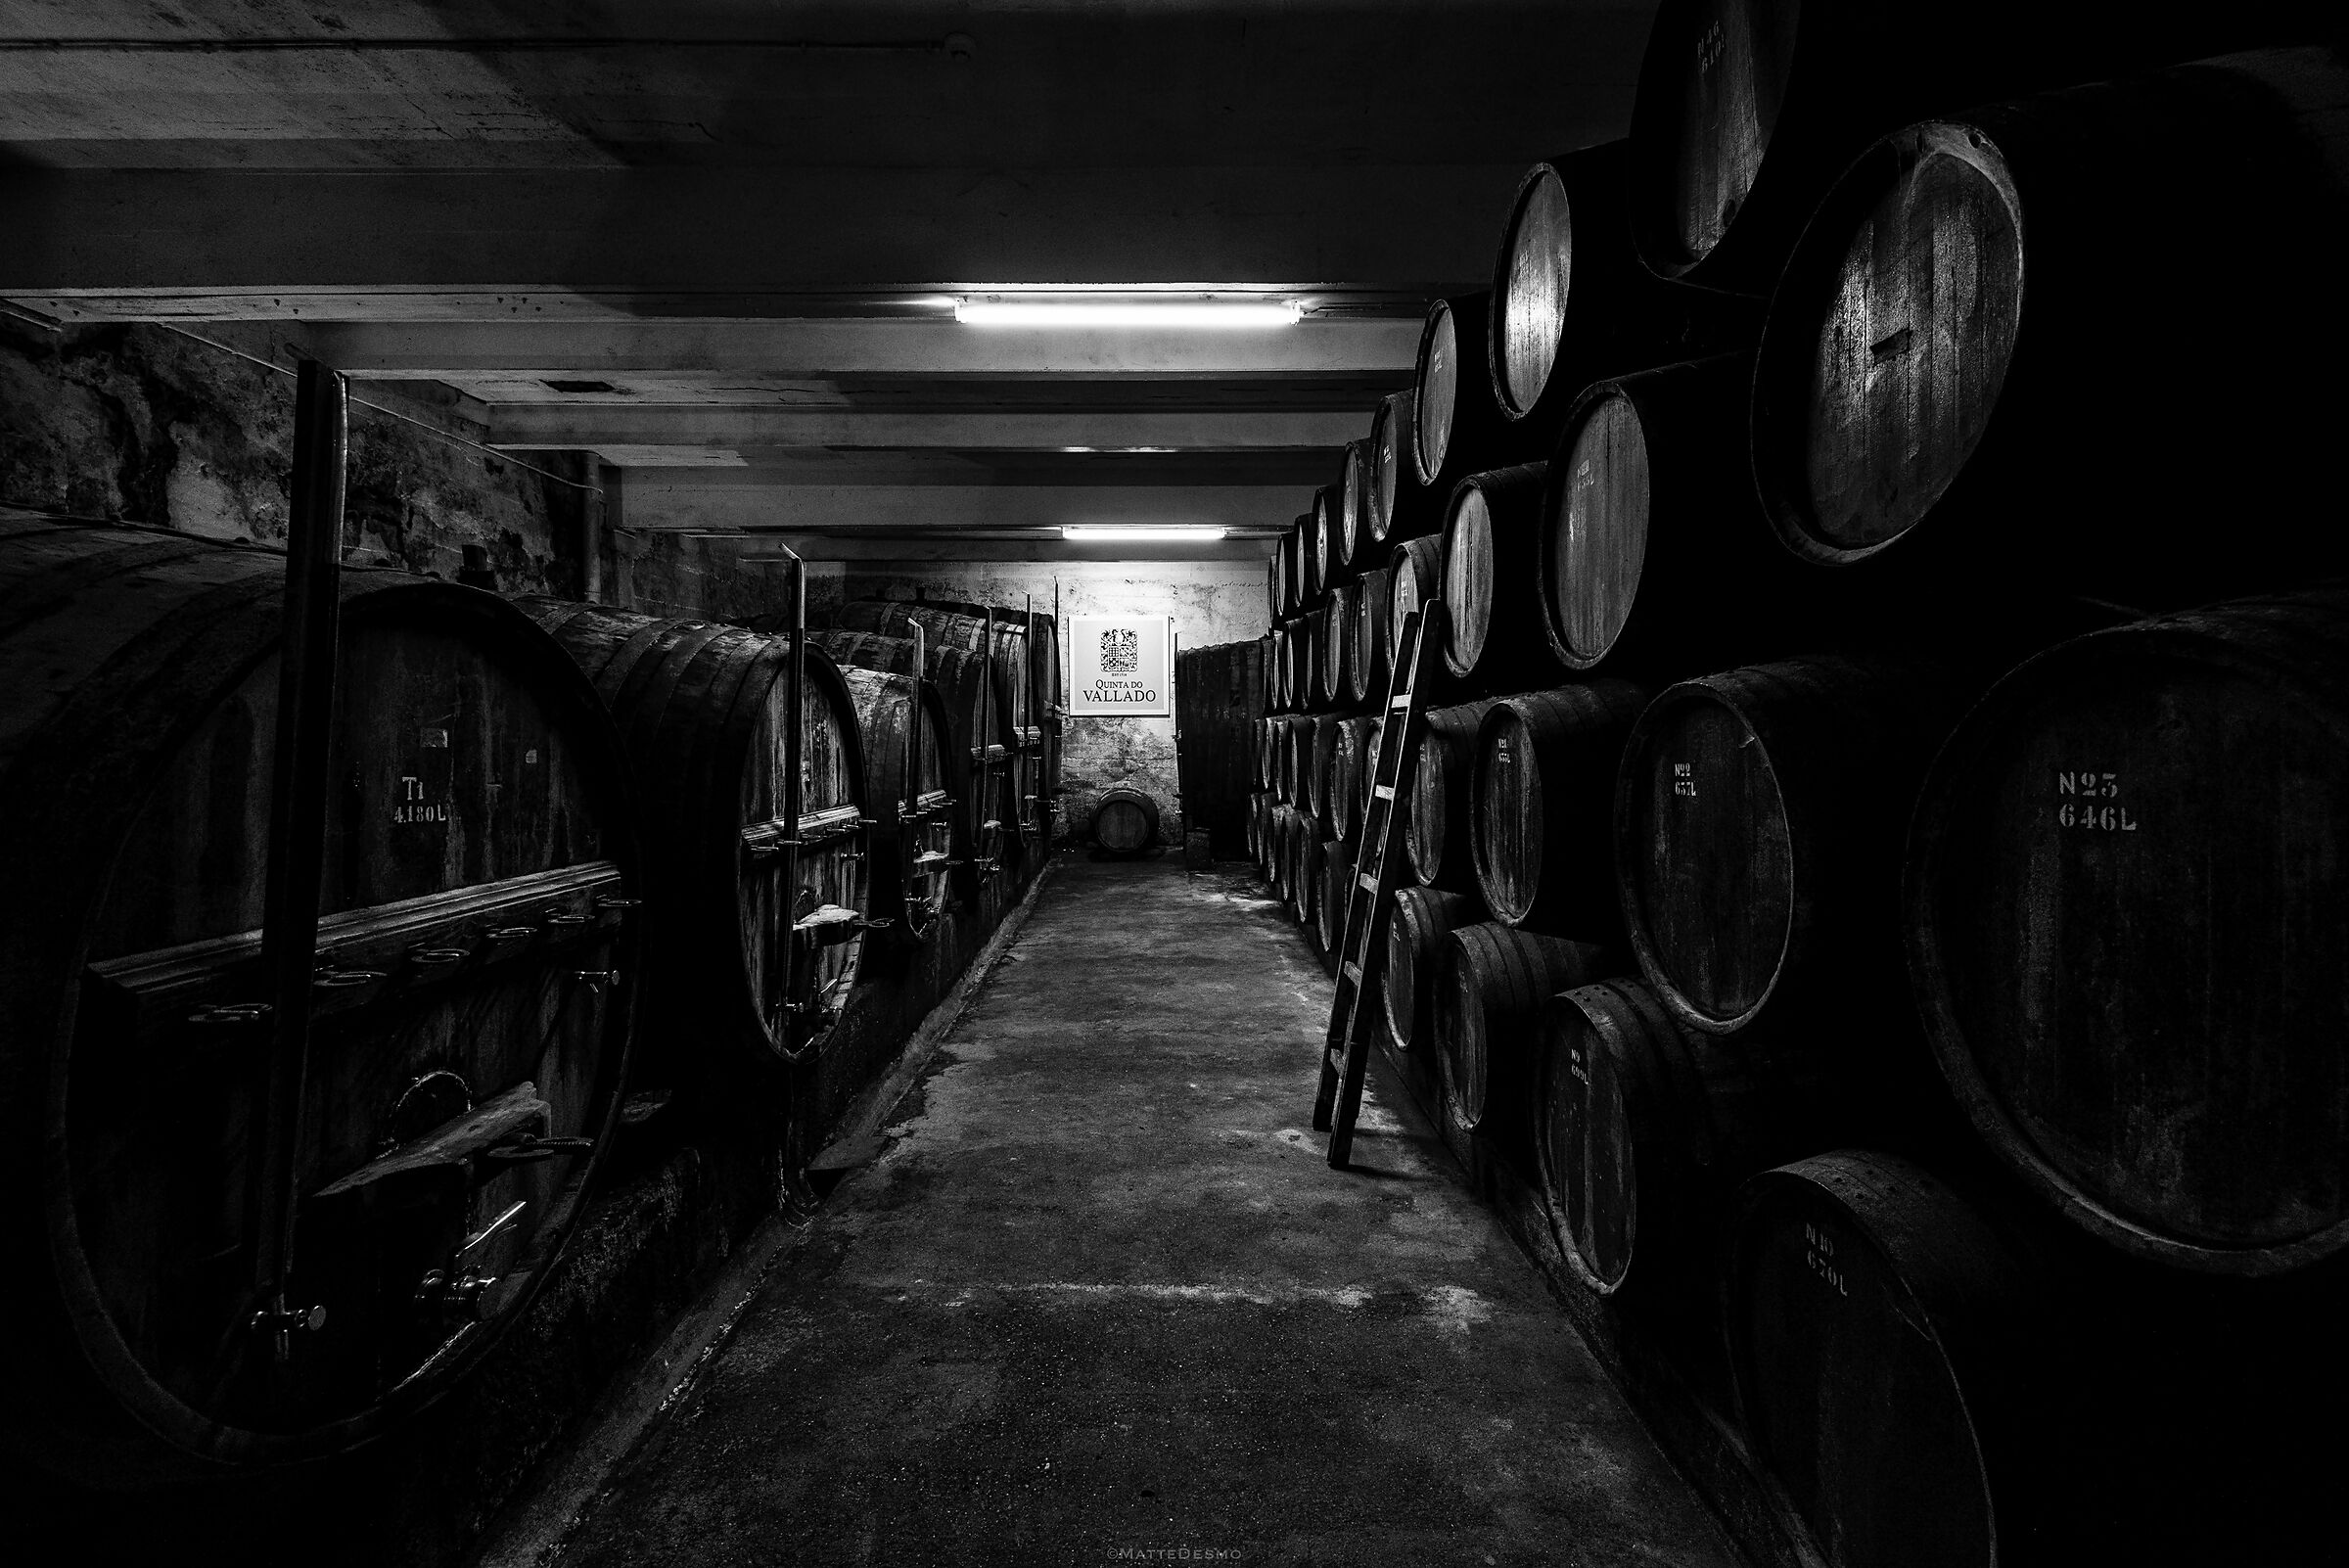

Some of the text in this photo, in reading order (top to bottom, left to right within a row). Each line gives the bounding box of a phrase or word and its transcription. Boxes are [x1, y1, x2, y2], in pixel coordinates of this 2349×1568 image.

[1095, 679, 1143, 690] QUINTA DO
[1082, 690, 1156, 702] VALLADO
[401, 776, 425, 801] T1
[2058, 804, 2139, 832] 646L
